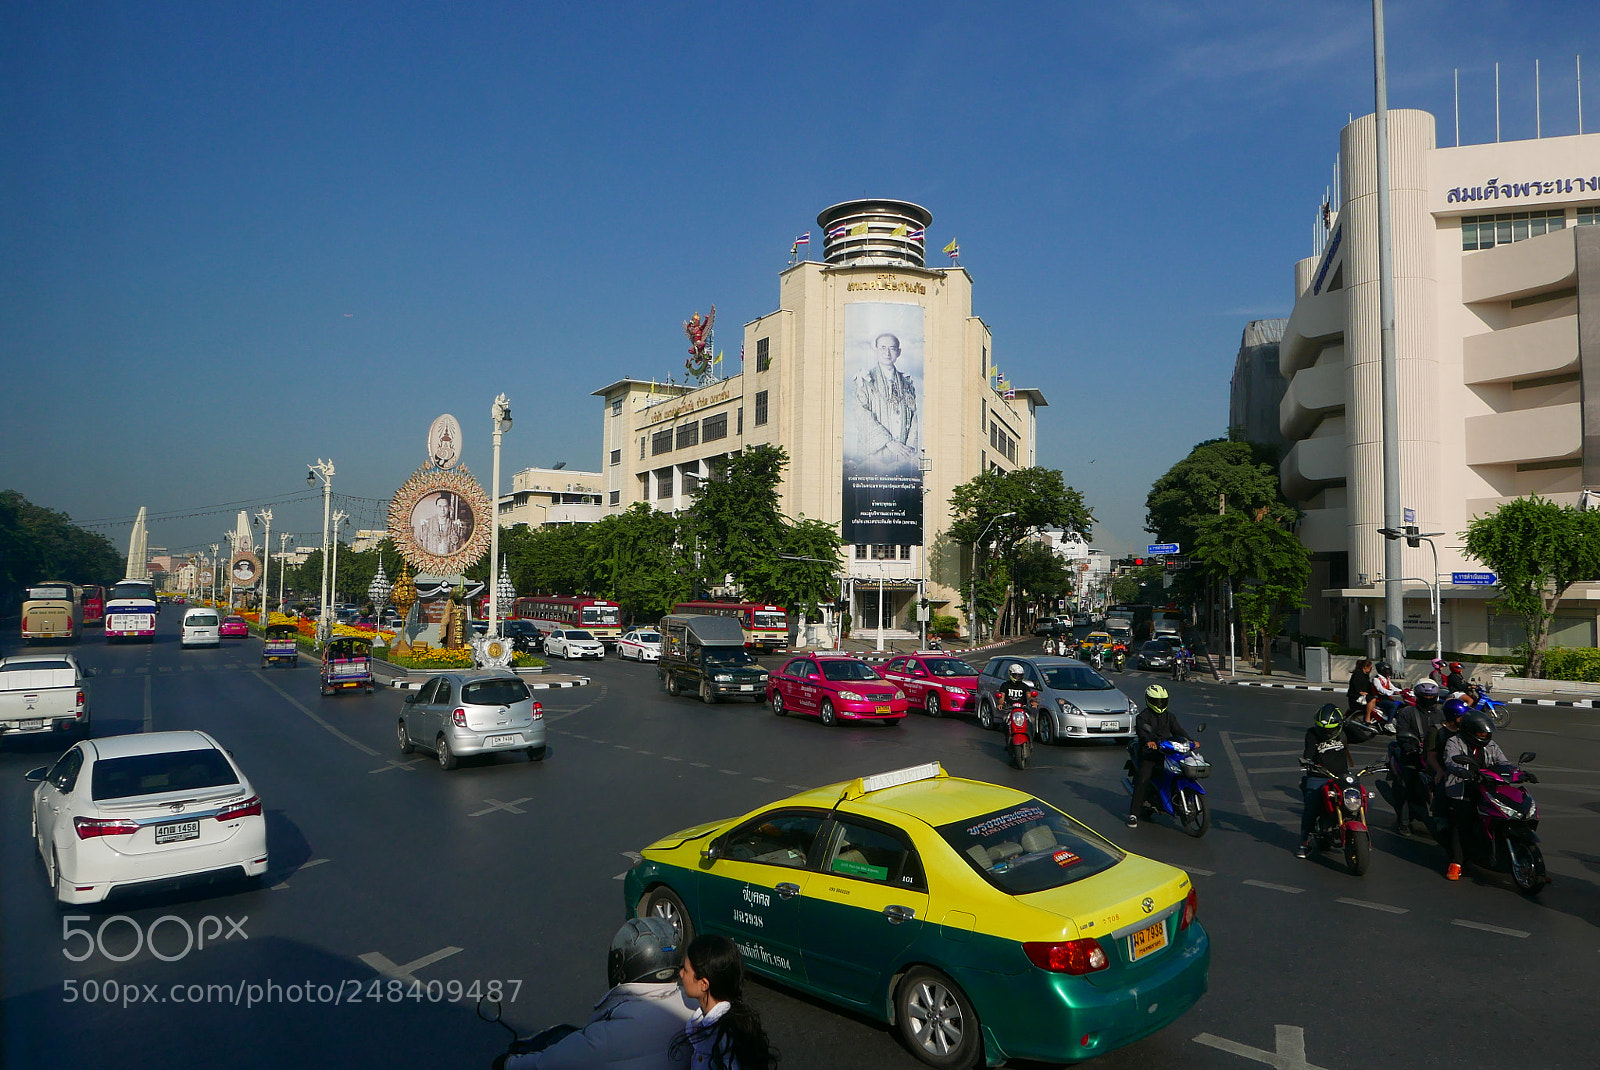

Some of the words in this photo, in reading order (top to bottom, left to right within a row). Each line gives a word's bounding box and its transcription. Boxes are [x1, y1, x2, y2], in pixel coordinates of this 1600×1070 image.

[1446, 176, 1600, 204] สมเด็จพระนาง
[1008, 688, 1023, 698] NTC
[177, 822, 197, 834] 1458
[1146, 922, 1164, 943] 7938
